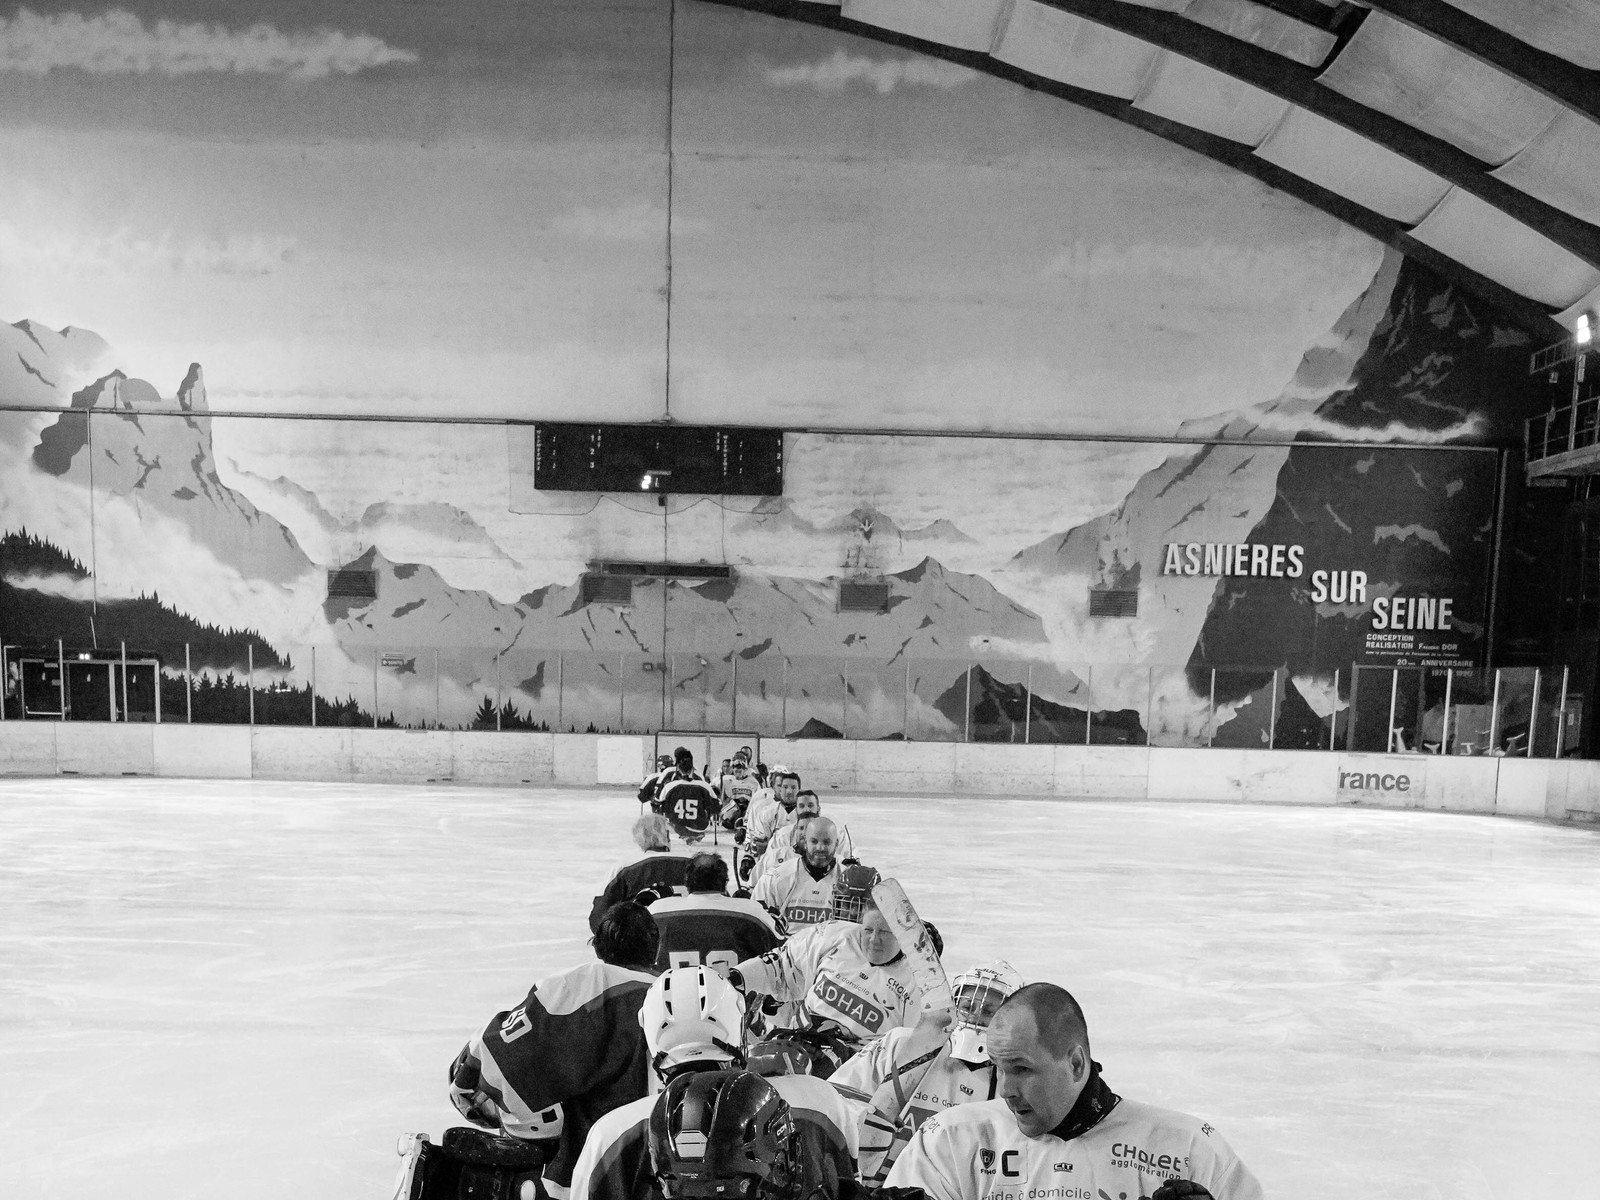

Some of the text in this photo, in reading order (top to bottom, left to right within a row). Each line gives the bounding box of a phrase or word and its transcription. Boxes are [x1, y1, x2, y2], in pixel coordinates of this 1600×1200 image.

[1163, 543, 1304, 578] ASNIERES
[1311, 570, 1368, 603] SUR
[1372, 598, 1453, 630] SEINE
[1366, 633, 1414, 642] CONCEPTION
[1339, 771, 1411, 792] rance
[674, 799, 699, 820] 45
[816, 979, 879, 1024] ADHAP
[1001, 1149, 1020, 1177] C
[1028, 1186, 1091, 1200] domicile
